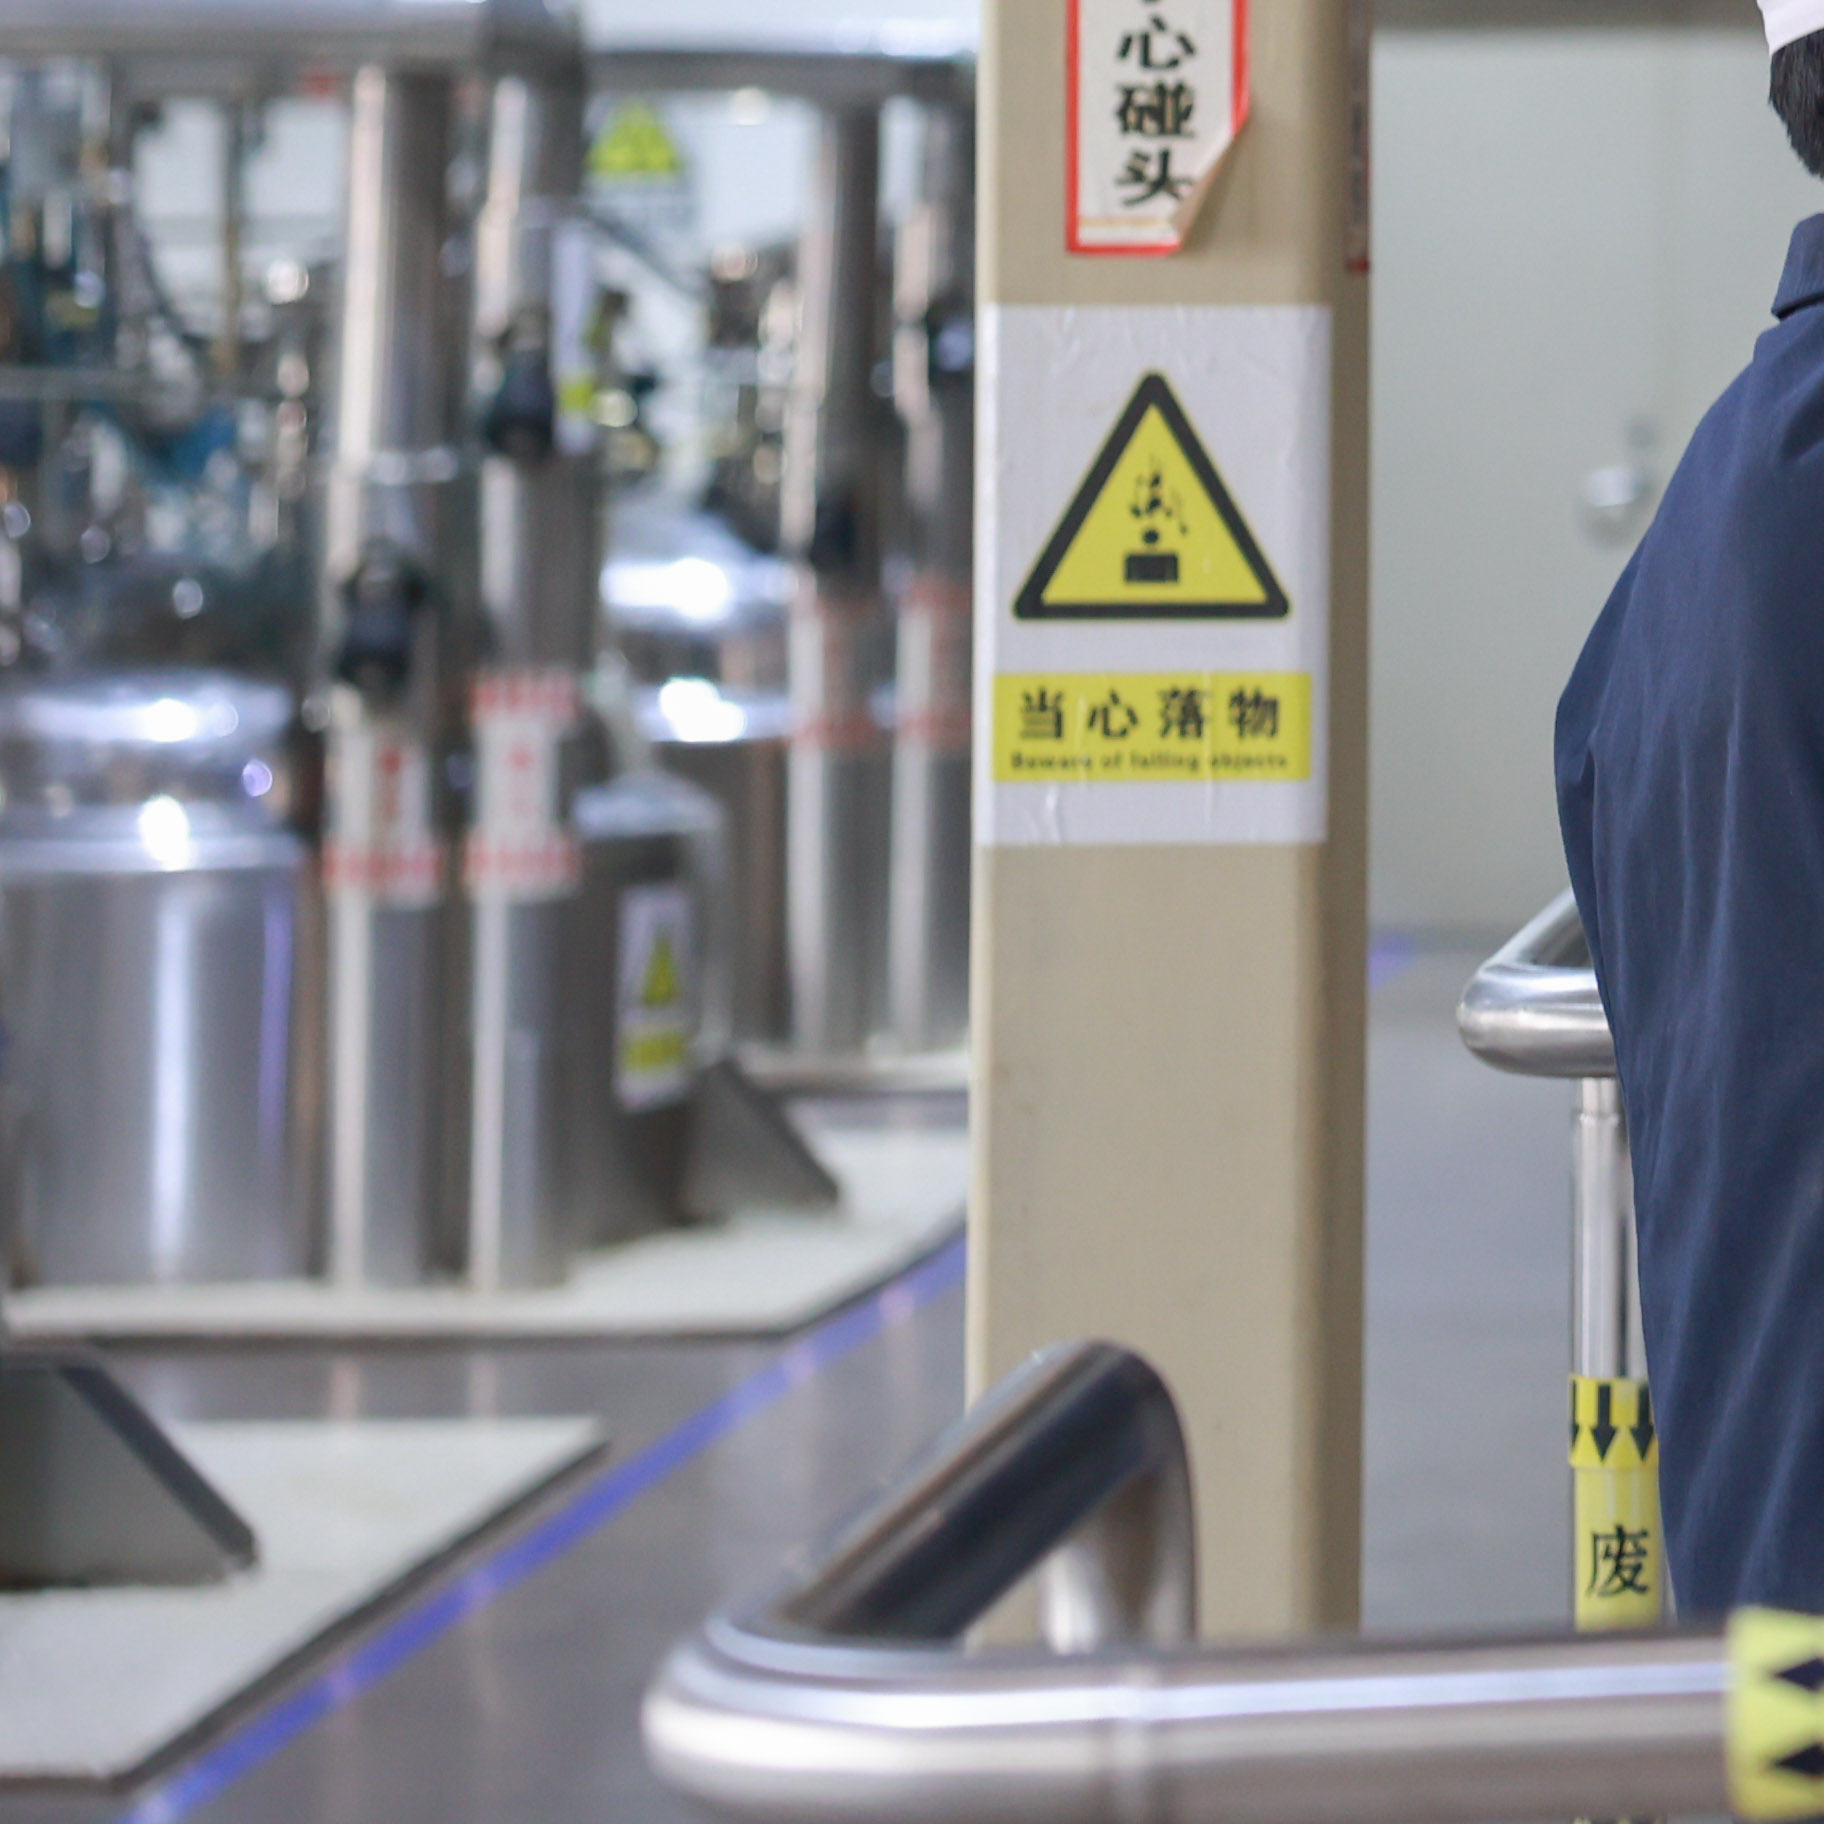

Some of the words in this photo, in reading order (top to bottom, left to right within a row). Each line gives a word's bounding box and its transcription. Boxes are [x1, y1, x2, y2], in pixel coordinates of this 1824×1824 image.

[1019, 685, 1280, 739] 当心落物
[1586, 1524, 1651, 1599] 废
